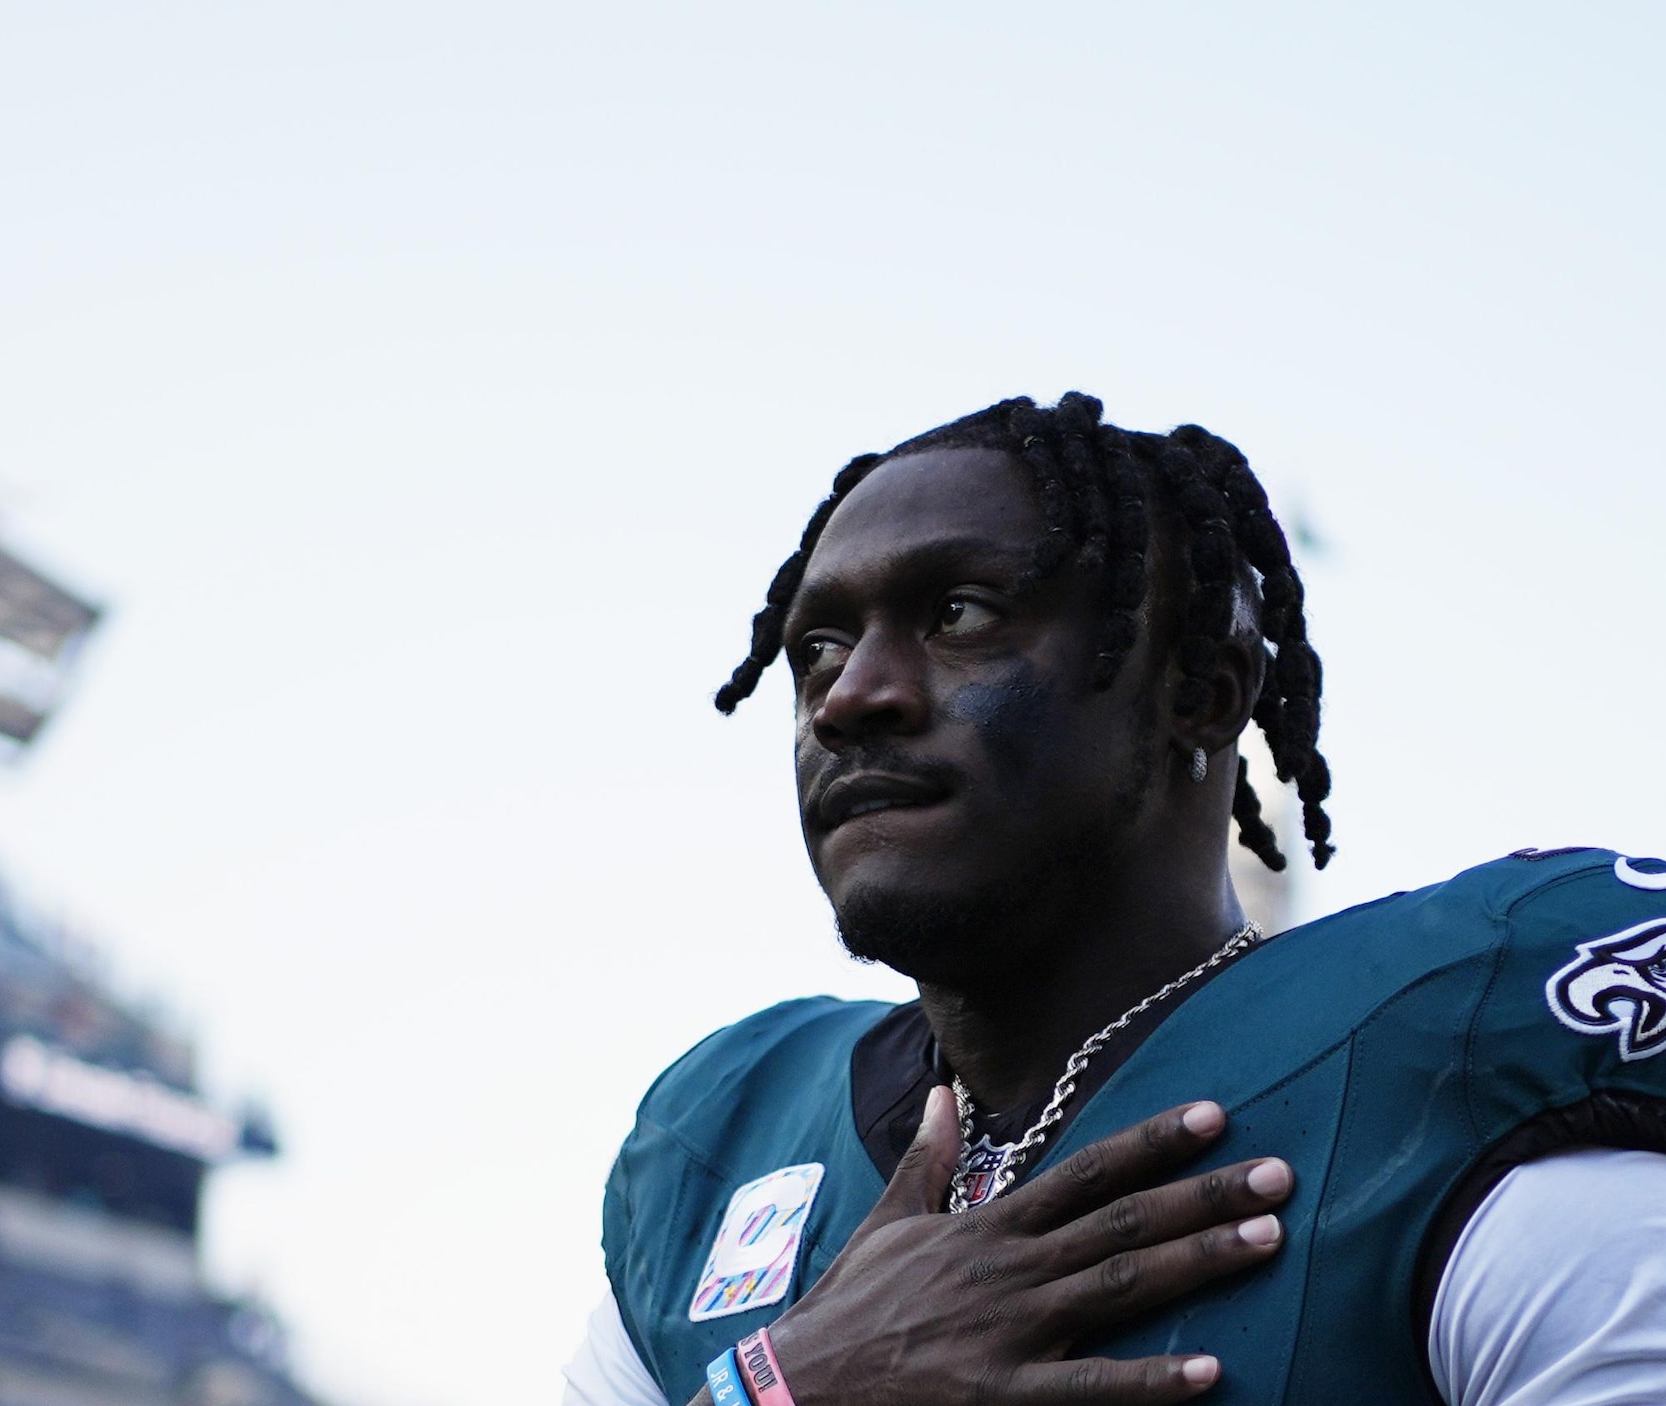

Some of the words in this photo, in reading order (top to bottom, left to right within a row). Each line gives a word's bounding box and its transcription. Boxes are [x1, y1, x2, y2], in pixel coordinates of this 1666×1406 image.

[711, 1367, 729, 1389] JR
[744, 1342, 779, 1394] YOU!
[716, 1384, 734, 1401] &
